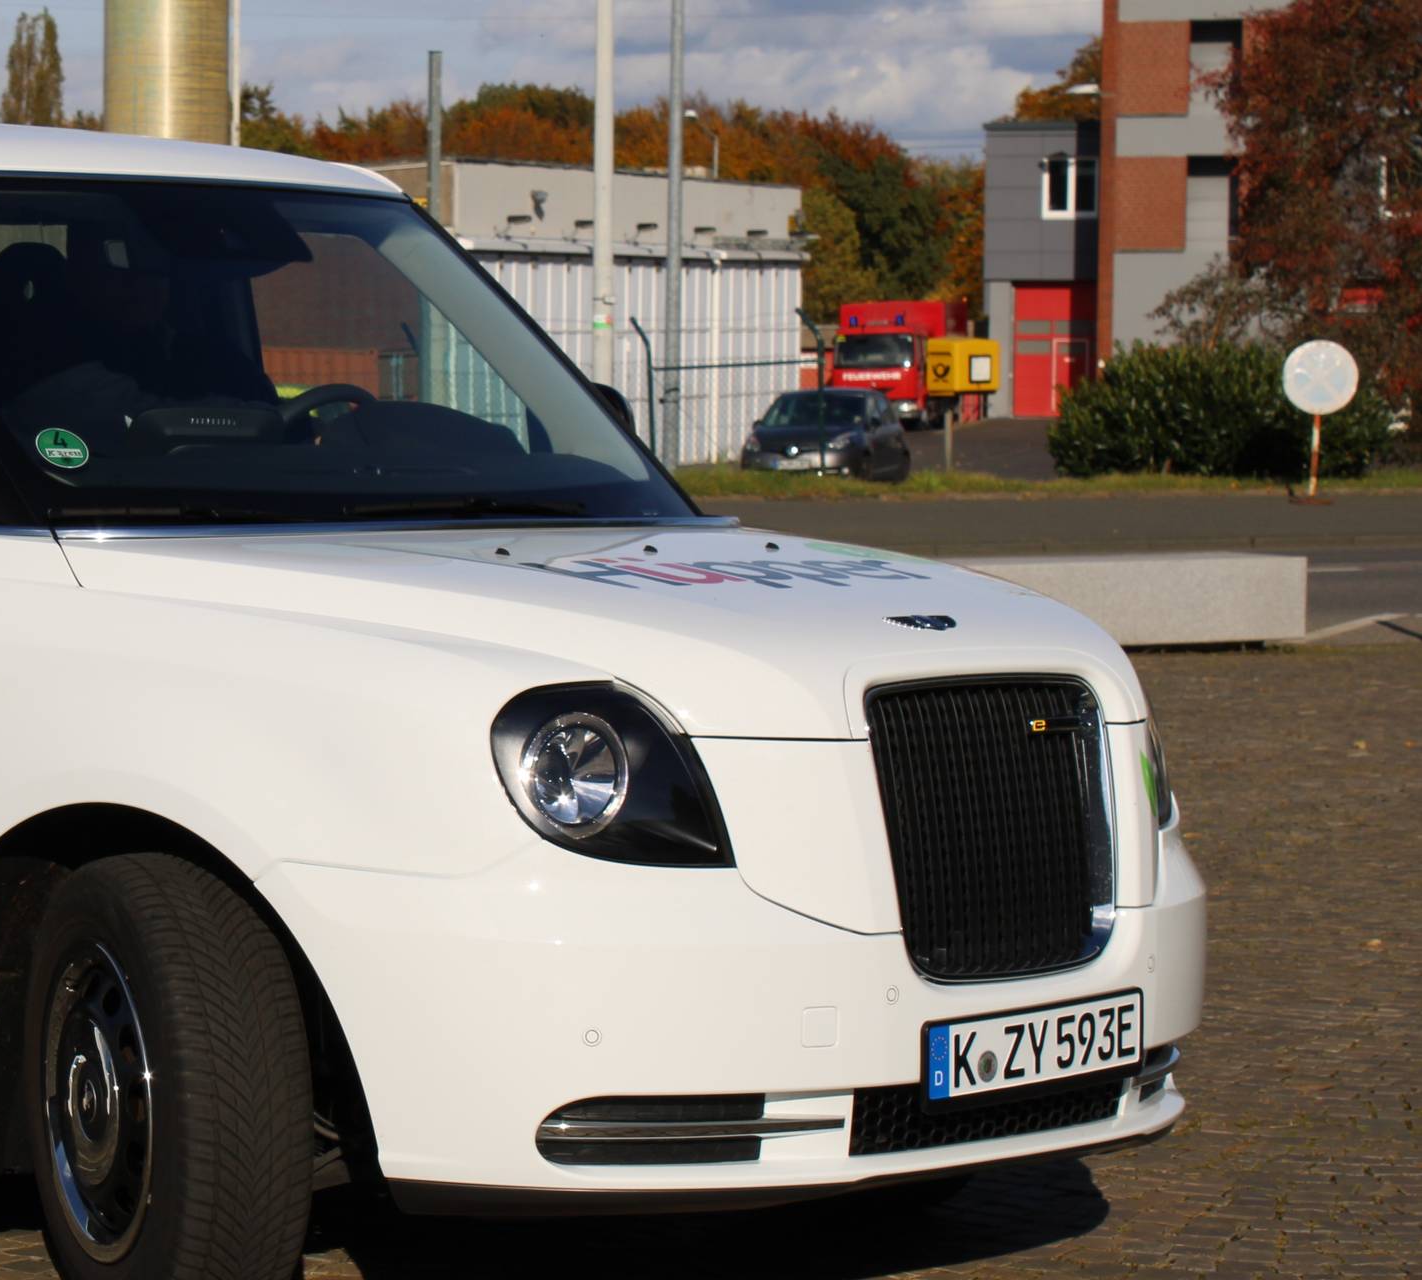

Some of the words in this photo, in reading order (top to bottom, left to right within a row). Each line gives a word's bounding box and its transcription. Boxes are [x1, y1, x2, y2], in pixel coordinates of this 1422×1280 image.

[842, 371, 901, 381] FEUERWEHR
[53, 431, 68, 448] 4
[519, 557, 931, 588] Hüpper
[954, 1031, 976, 1088] K
[1004, 1019, 1048, 1080] ZY
[934, 1070, 943, 1086] D
